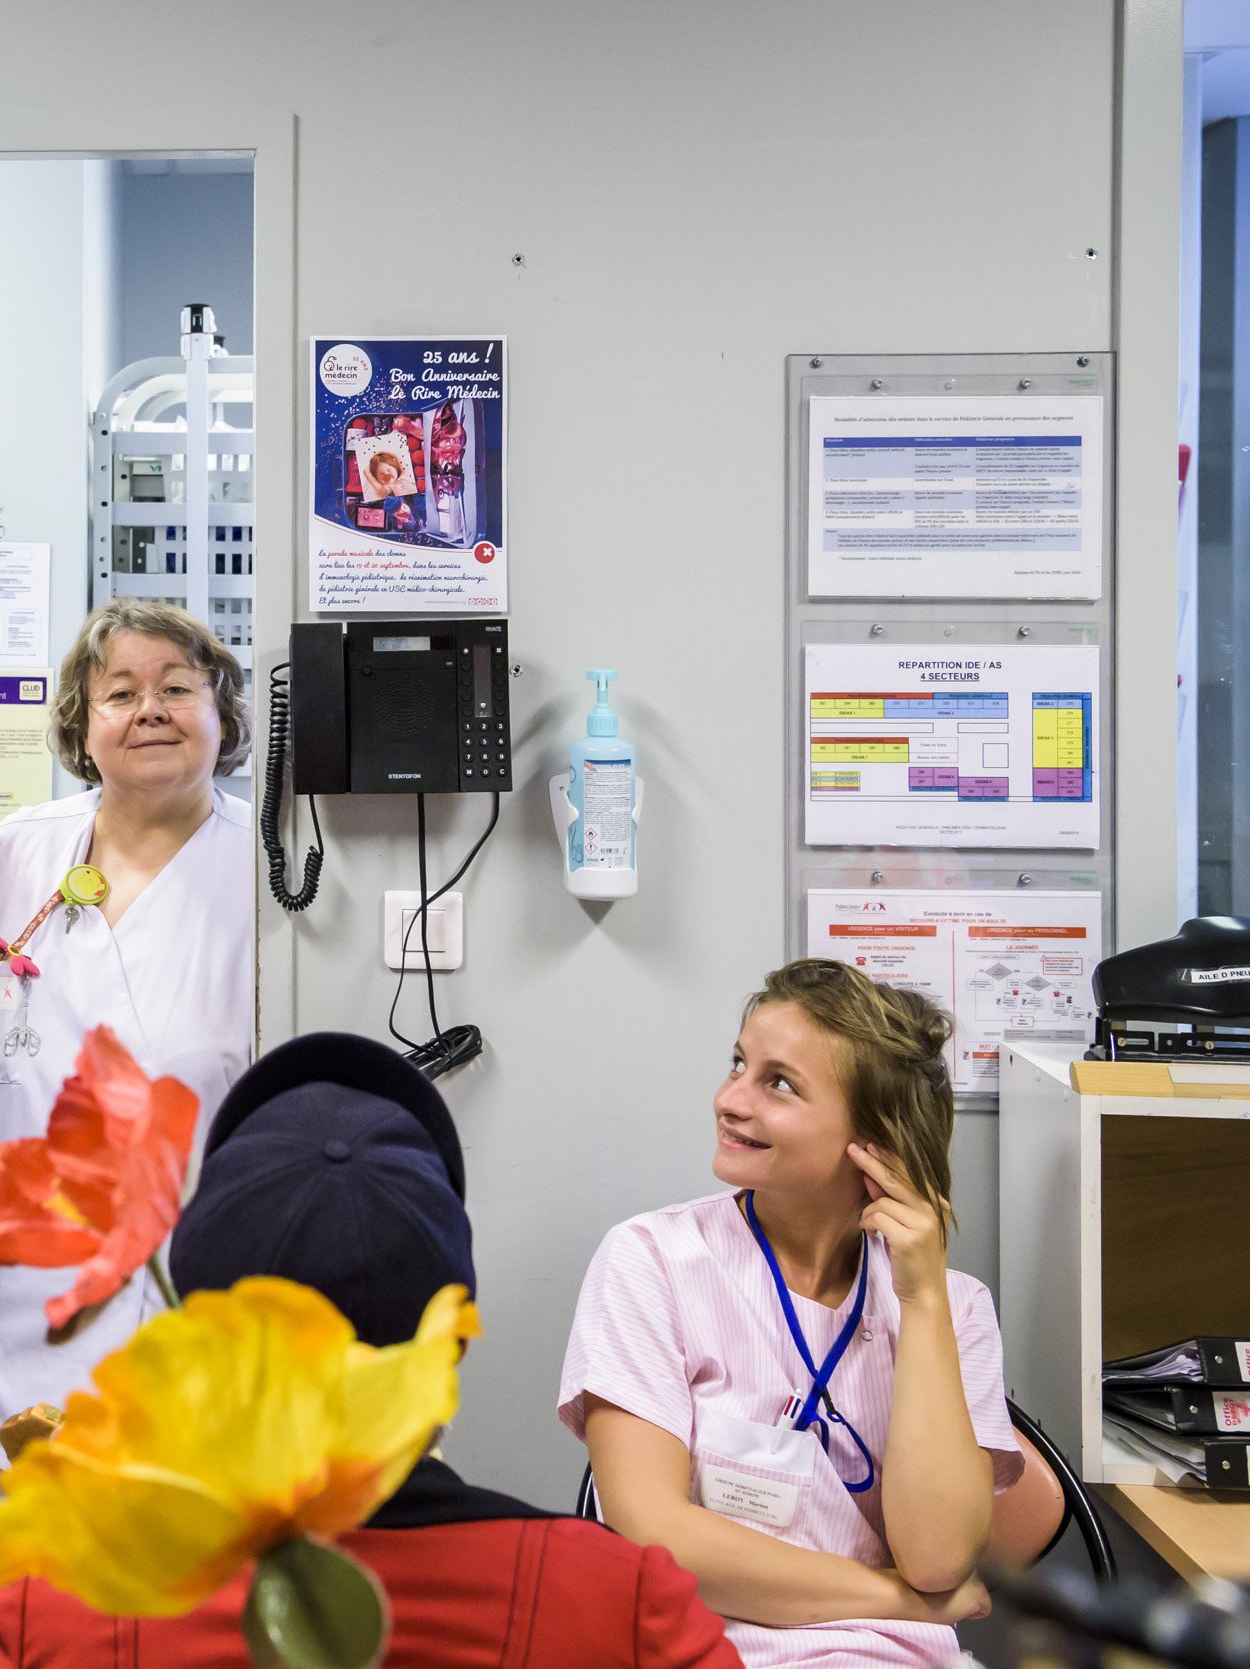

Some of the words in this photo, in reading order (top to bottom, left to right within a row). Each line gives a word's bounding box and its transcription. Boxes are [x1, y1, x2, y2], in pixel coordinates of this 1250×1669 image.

[423, 351, 442, 364] 25
[448, 353, 480, 364] ans
[484, 342, 494, 364] !
[390, 368, 415, 382] Bon
[422, 368, 500, 382] Anniversaire
[388, 385, 405, 400] Le
[412, 385, 442, 400] Rire
[446, 385, 500, 400] Médecin
[327, 550, 347, 559] parade
[327, 585, 354, 594] pédiatrie
[355, 585, 379, 594] générale
[328, 597, 340, 606] plus
[1223, 1397, 1232, 1426] Office
[722, 1493, 744, 1503] LEROY
[749, 1500, 768, 1510] Marion
